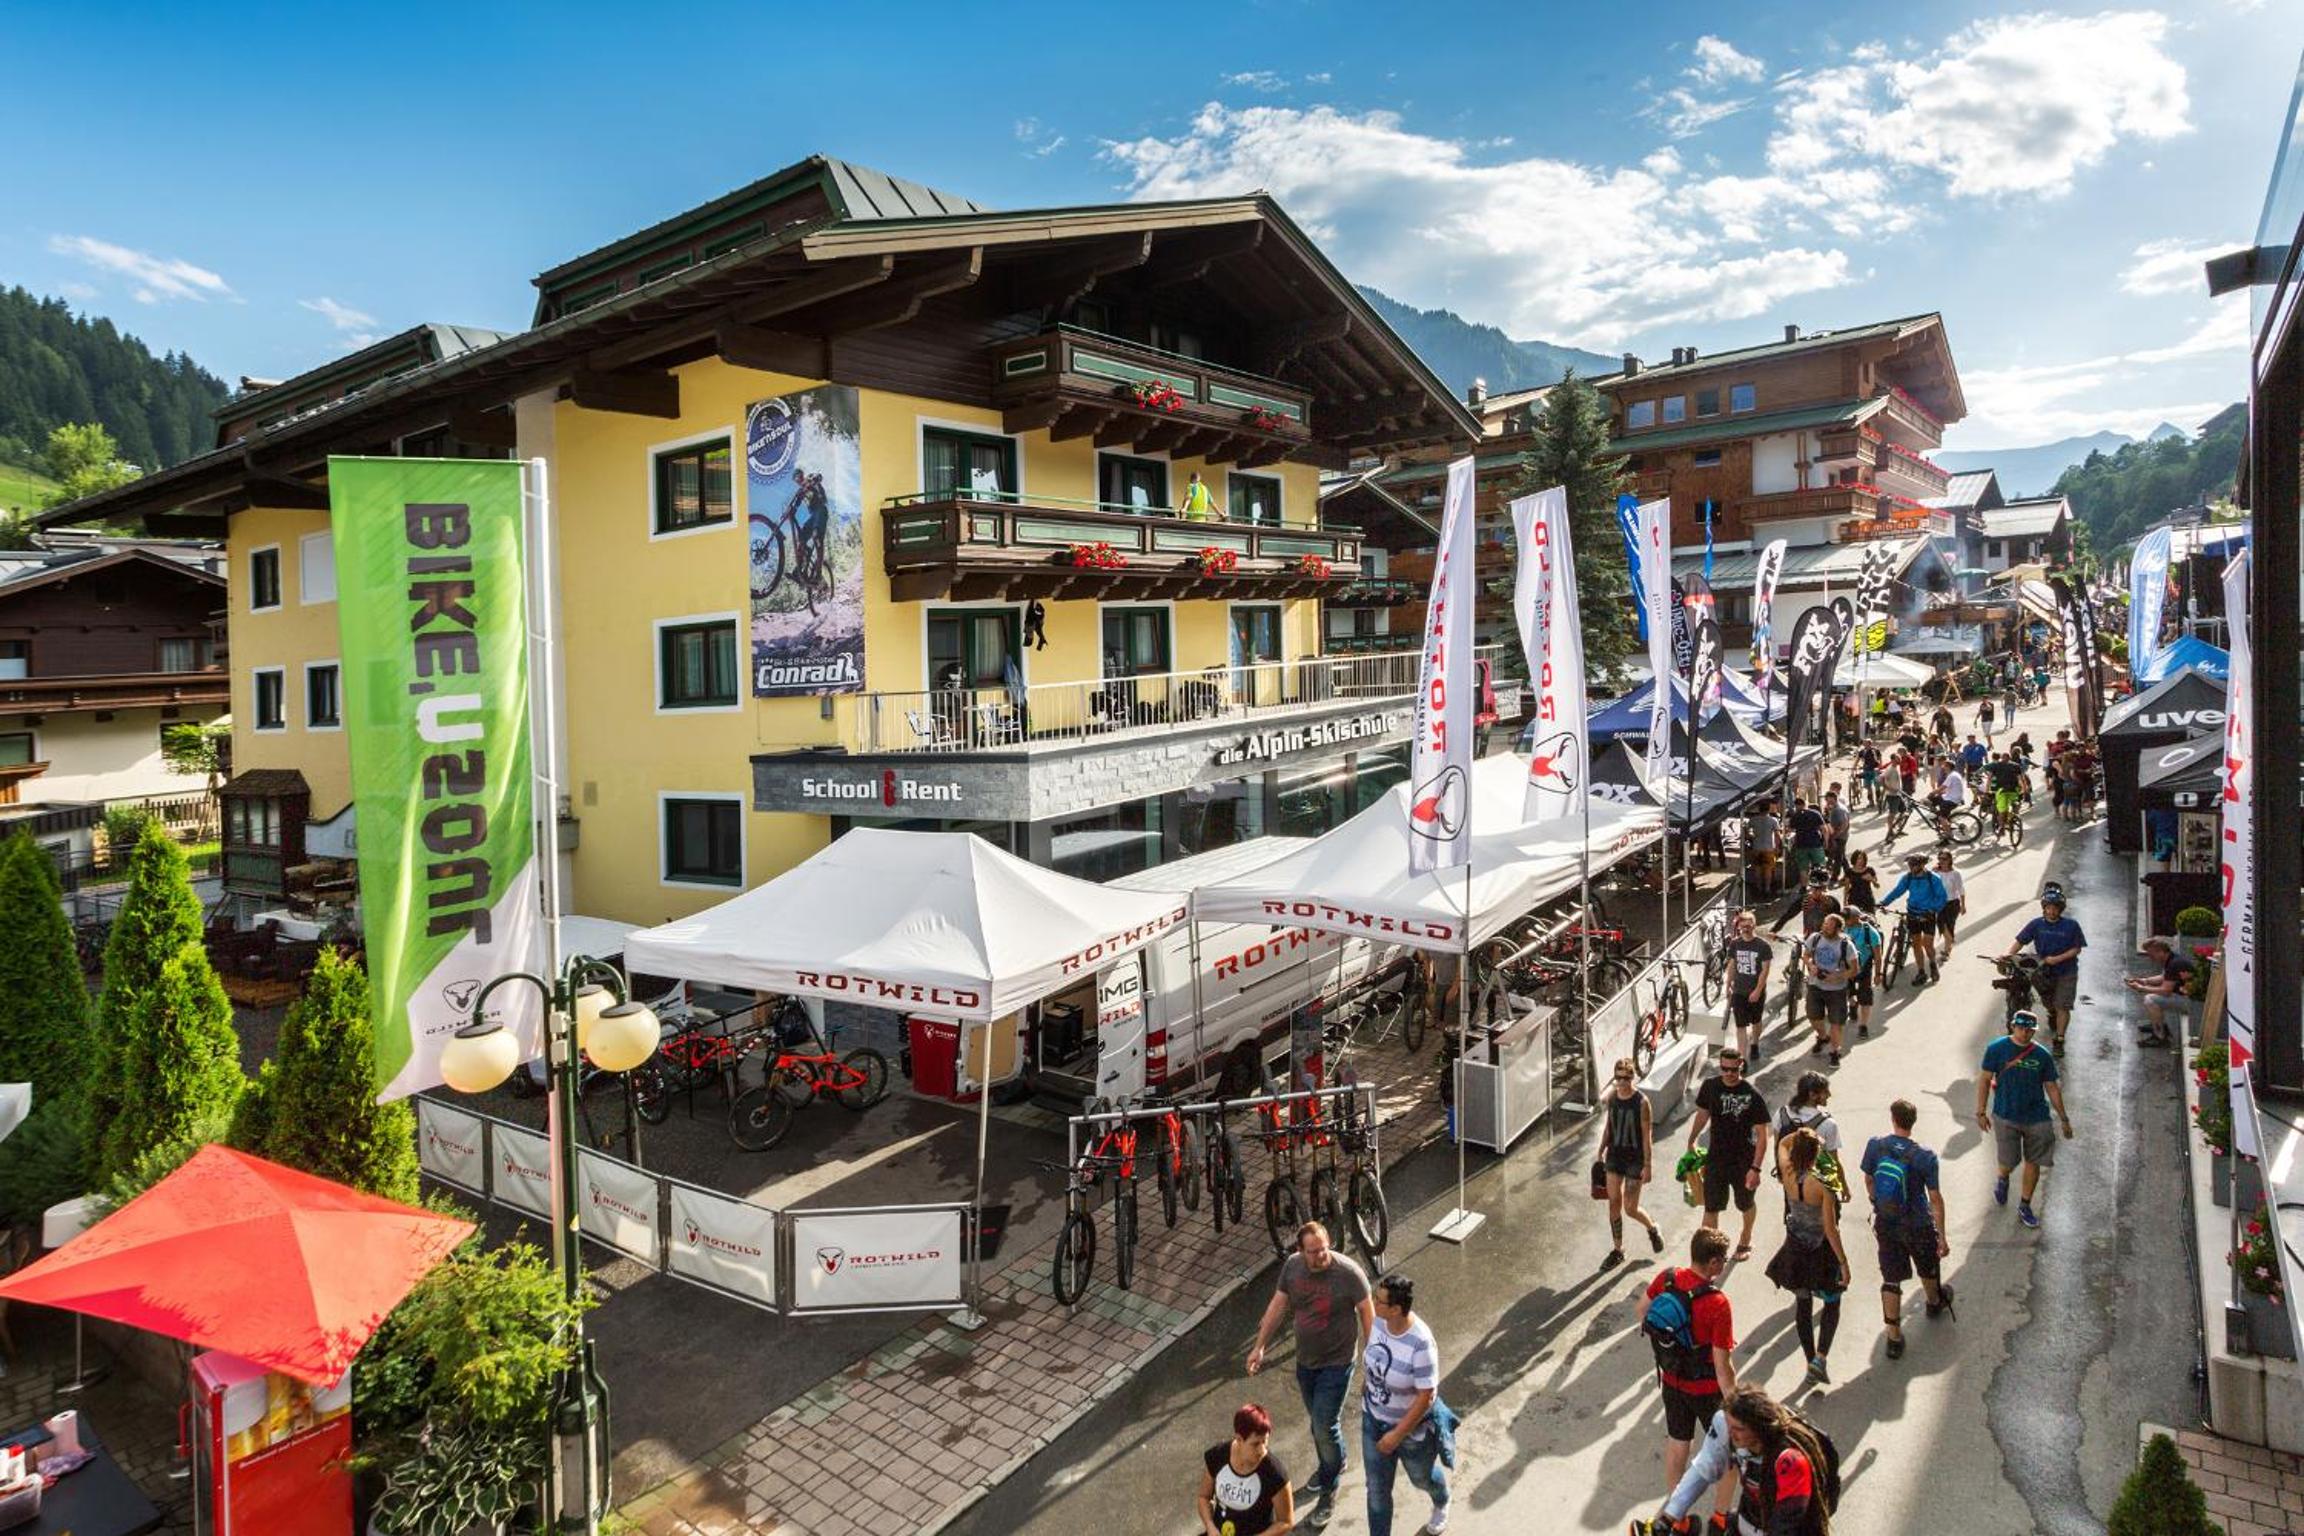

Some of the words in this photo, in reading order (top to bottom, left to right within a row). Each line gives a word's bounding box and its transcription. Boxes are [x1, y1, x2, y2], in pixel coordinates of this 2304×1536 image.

[758, 658, 845, 689] Conrad
[1220, 749, 1245, 764] die
[802, 778, 877, 798] School
[902, 780, 962, 800] Rent
[1262, 900, 1453, 940] ROTWILD
[1060, 906, 1187, 975] ROTWILD
[797, 970, 980, 1008] ROTWILD
[701, 1234, 761, 1256] ROTWILD
[849, 1250, 941, 1265] ROTWILD
